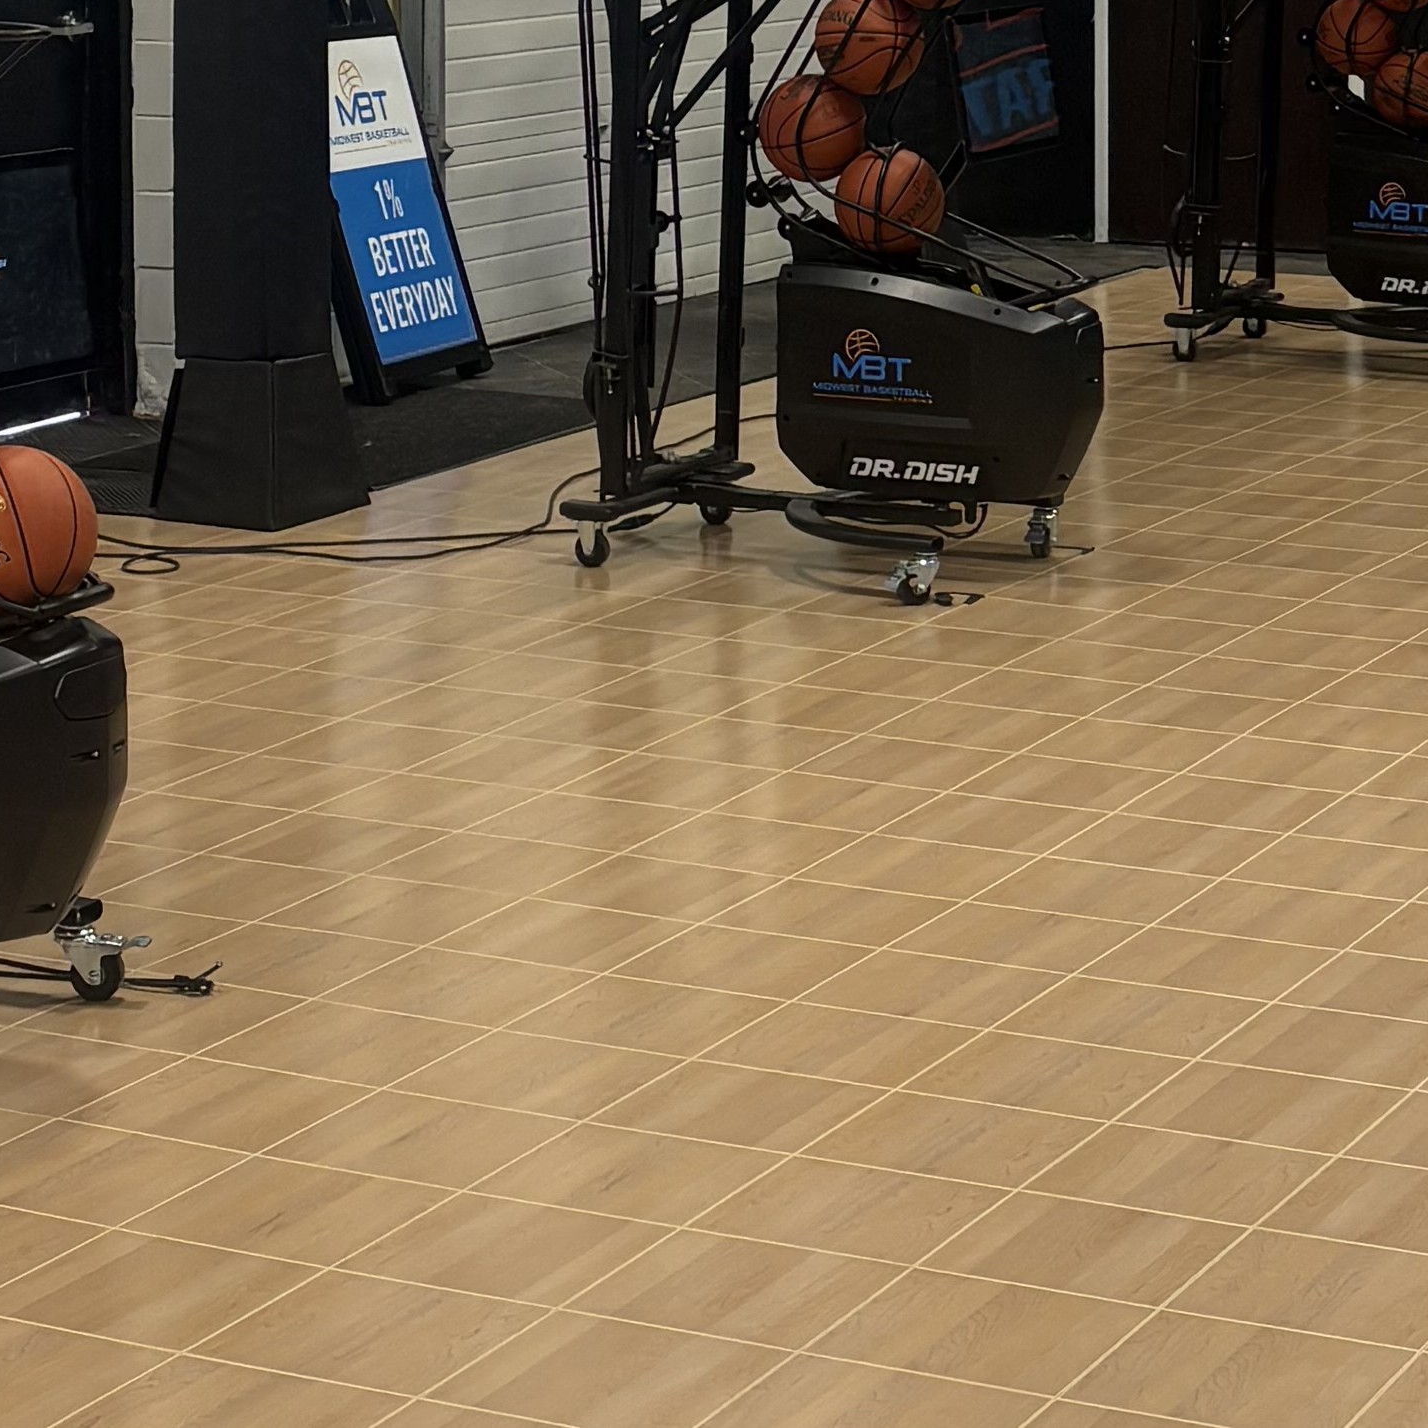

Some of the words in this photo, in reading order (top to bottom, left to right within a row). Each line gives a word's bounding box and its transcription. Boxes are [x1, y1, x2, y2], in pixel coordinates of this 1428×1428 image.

[334, 89, 387, 127] MBT
[329, 132, 364, 146] MIDWEST
[365, 127, 410, 142] BASKETBALL
[373, 178, 404, 221] 1%
[367, 227, 436, 278] BETTER
[370, 275, 459, 333] EVERYDAY
[832, 352, 912, 382] MBT
[812, 381, 861, 393] MIDWEST
[863, 384, 933, 398] BASKETBALL
